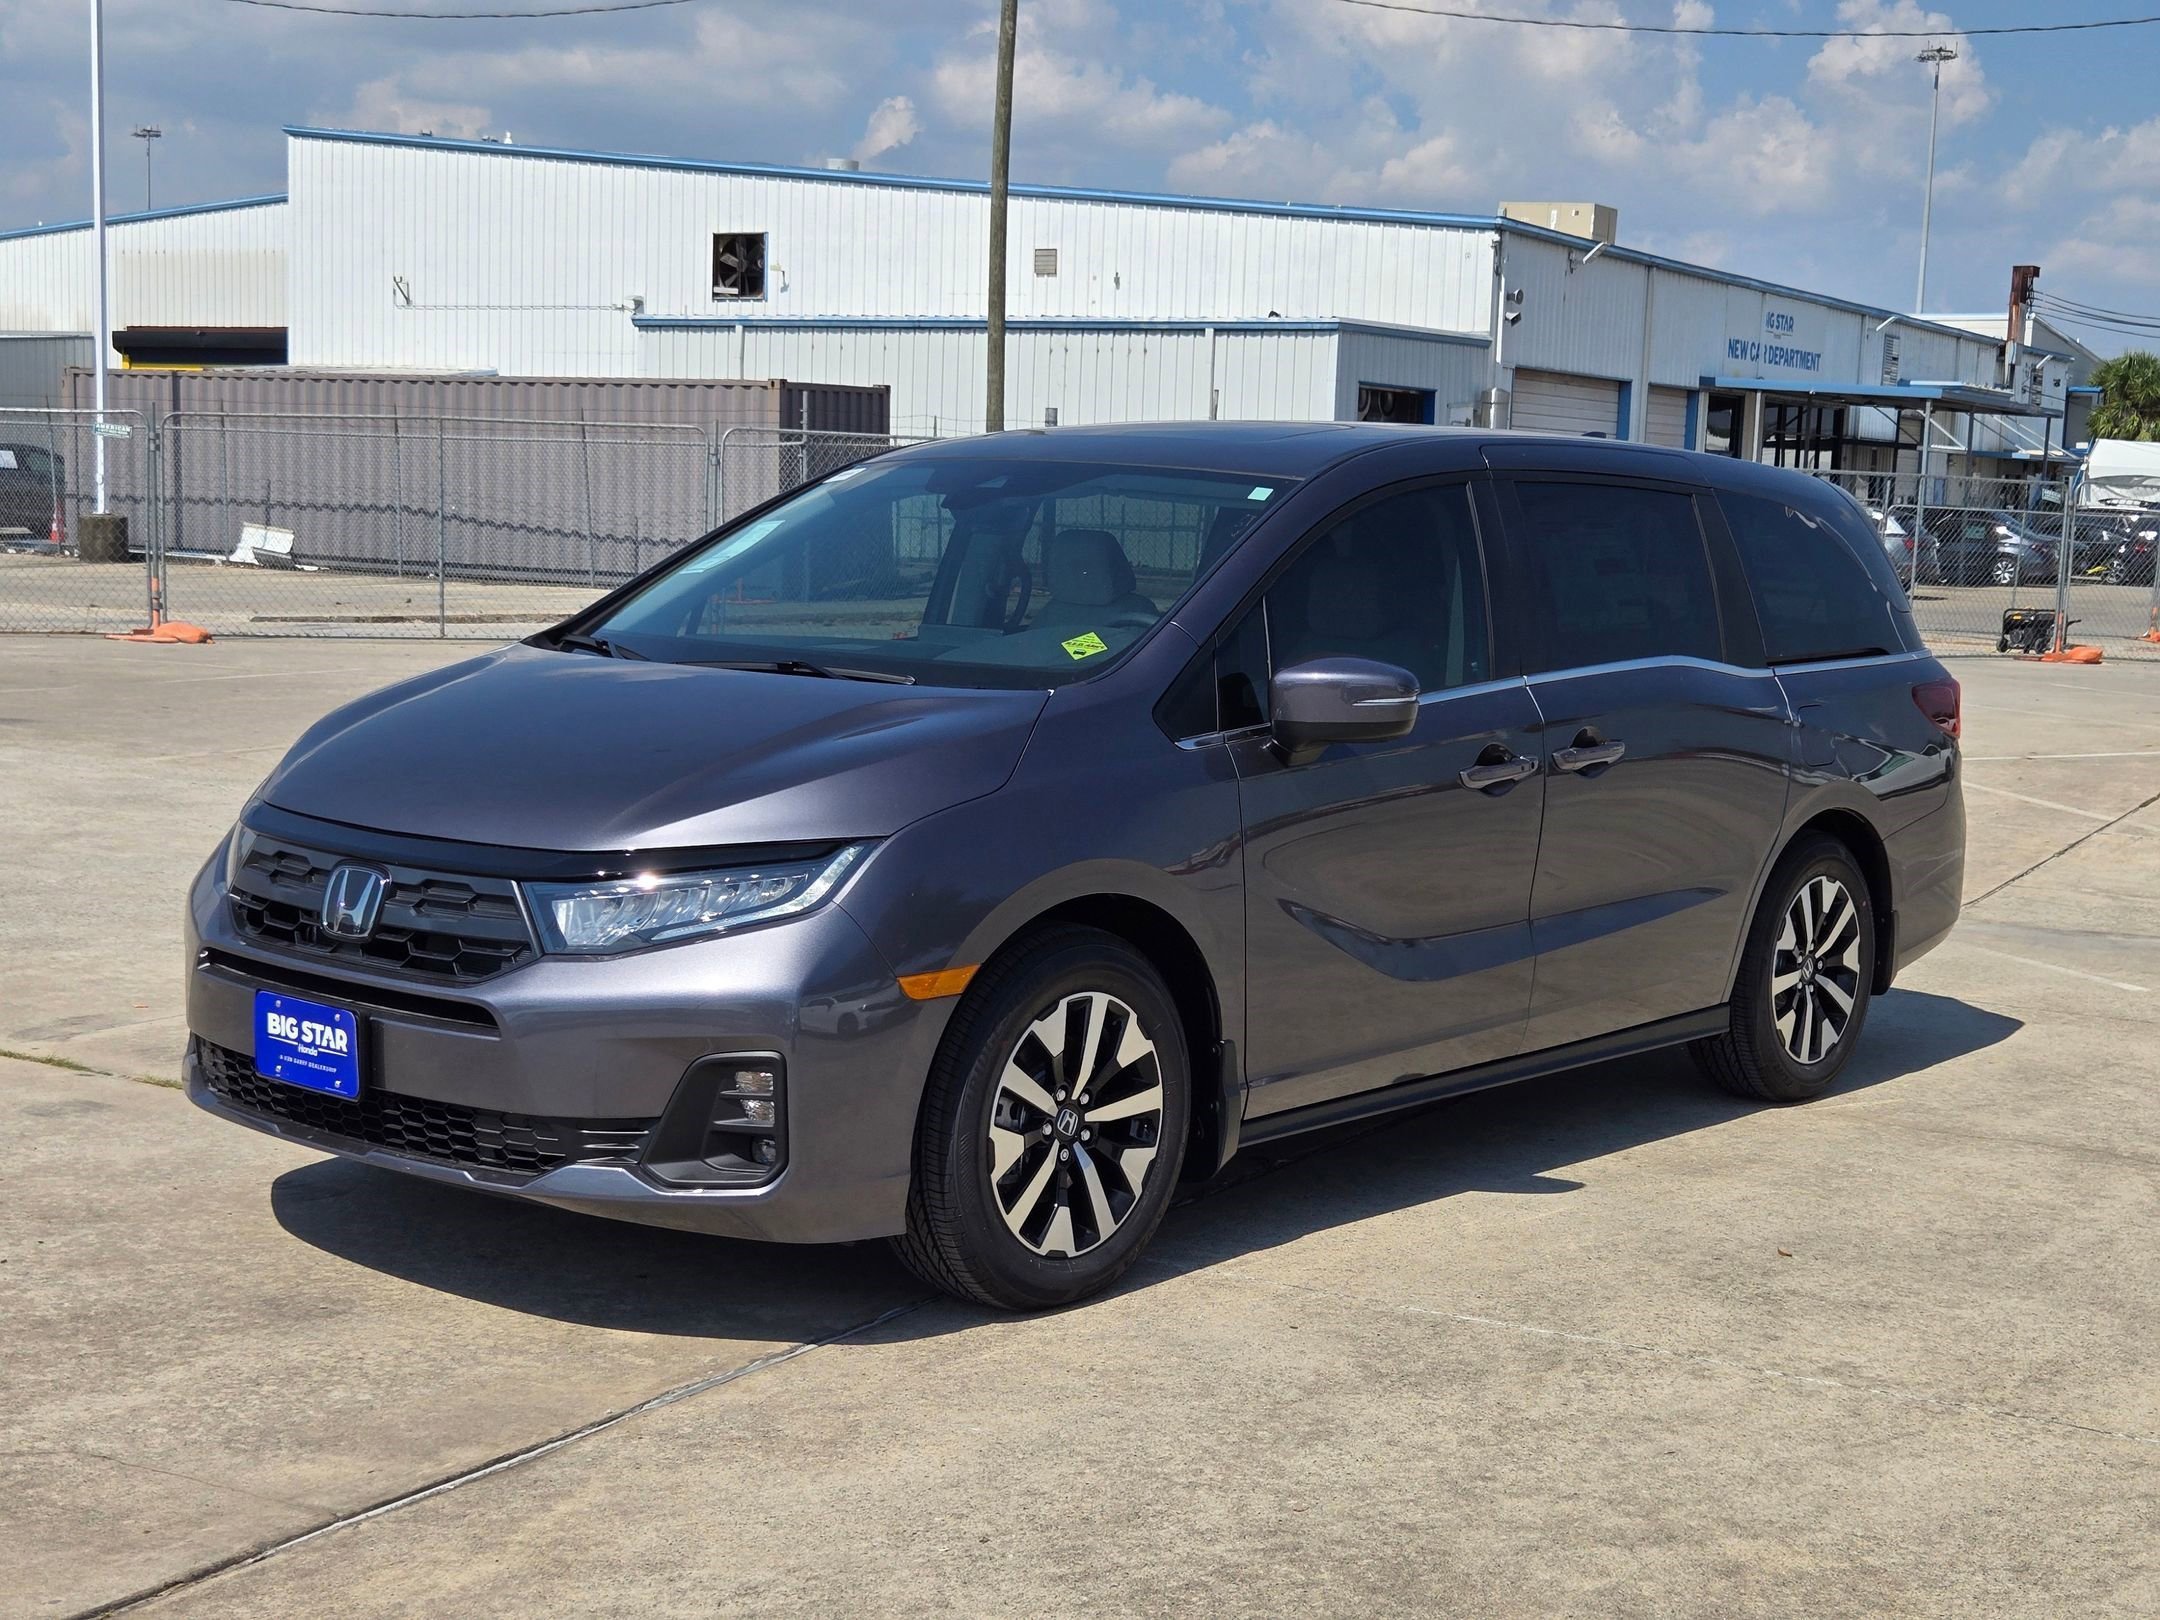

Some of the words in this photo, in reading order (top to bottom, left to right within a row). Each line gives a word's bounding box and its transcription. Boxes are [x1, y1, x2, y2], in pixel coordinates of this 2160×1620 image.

[1776, 313, 1794, 332] STAR
[1727, 338, 1749, 361] NEW
[1768, 345, 1822, 373] DEPARTMENT
[267, 1012, 299, 1040] BIG
[301, 1020, 348, 1053] STAR
[298, 1044, 318, 1057] Honda
